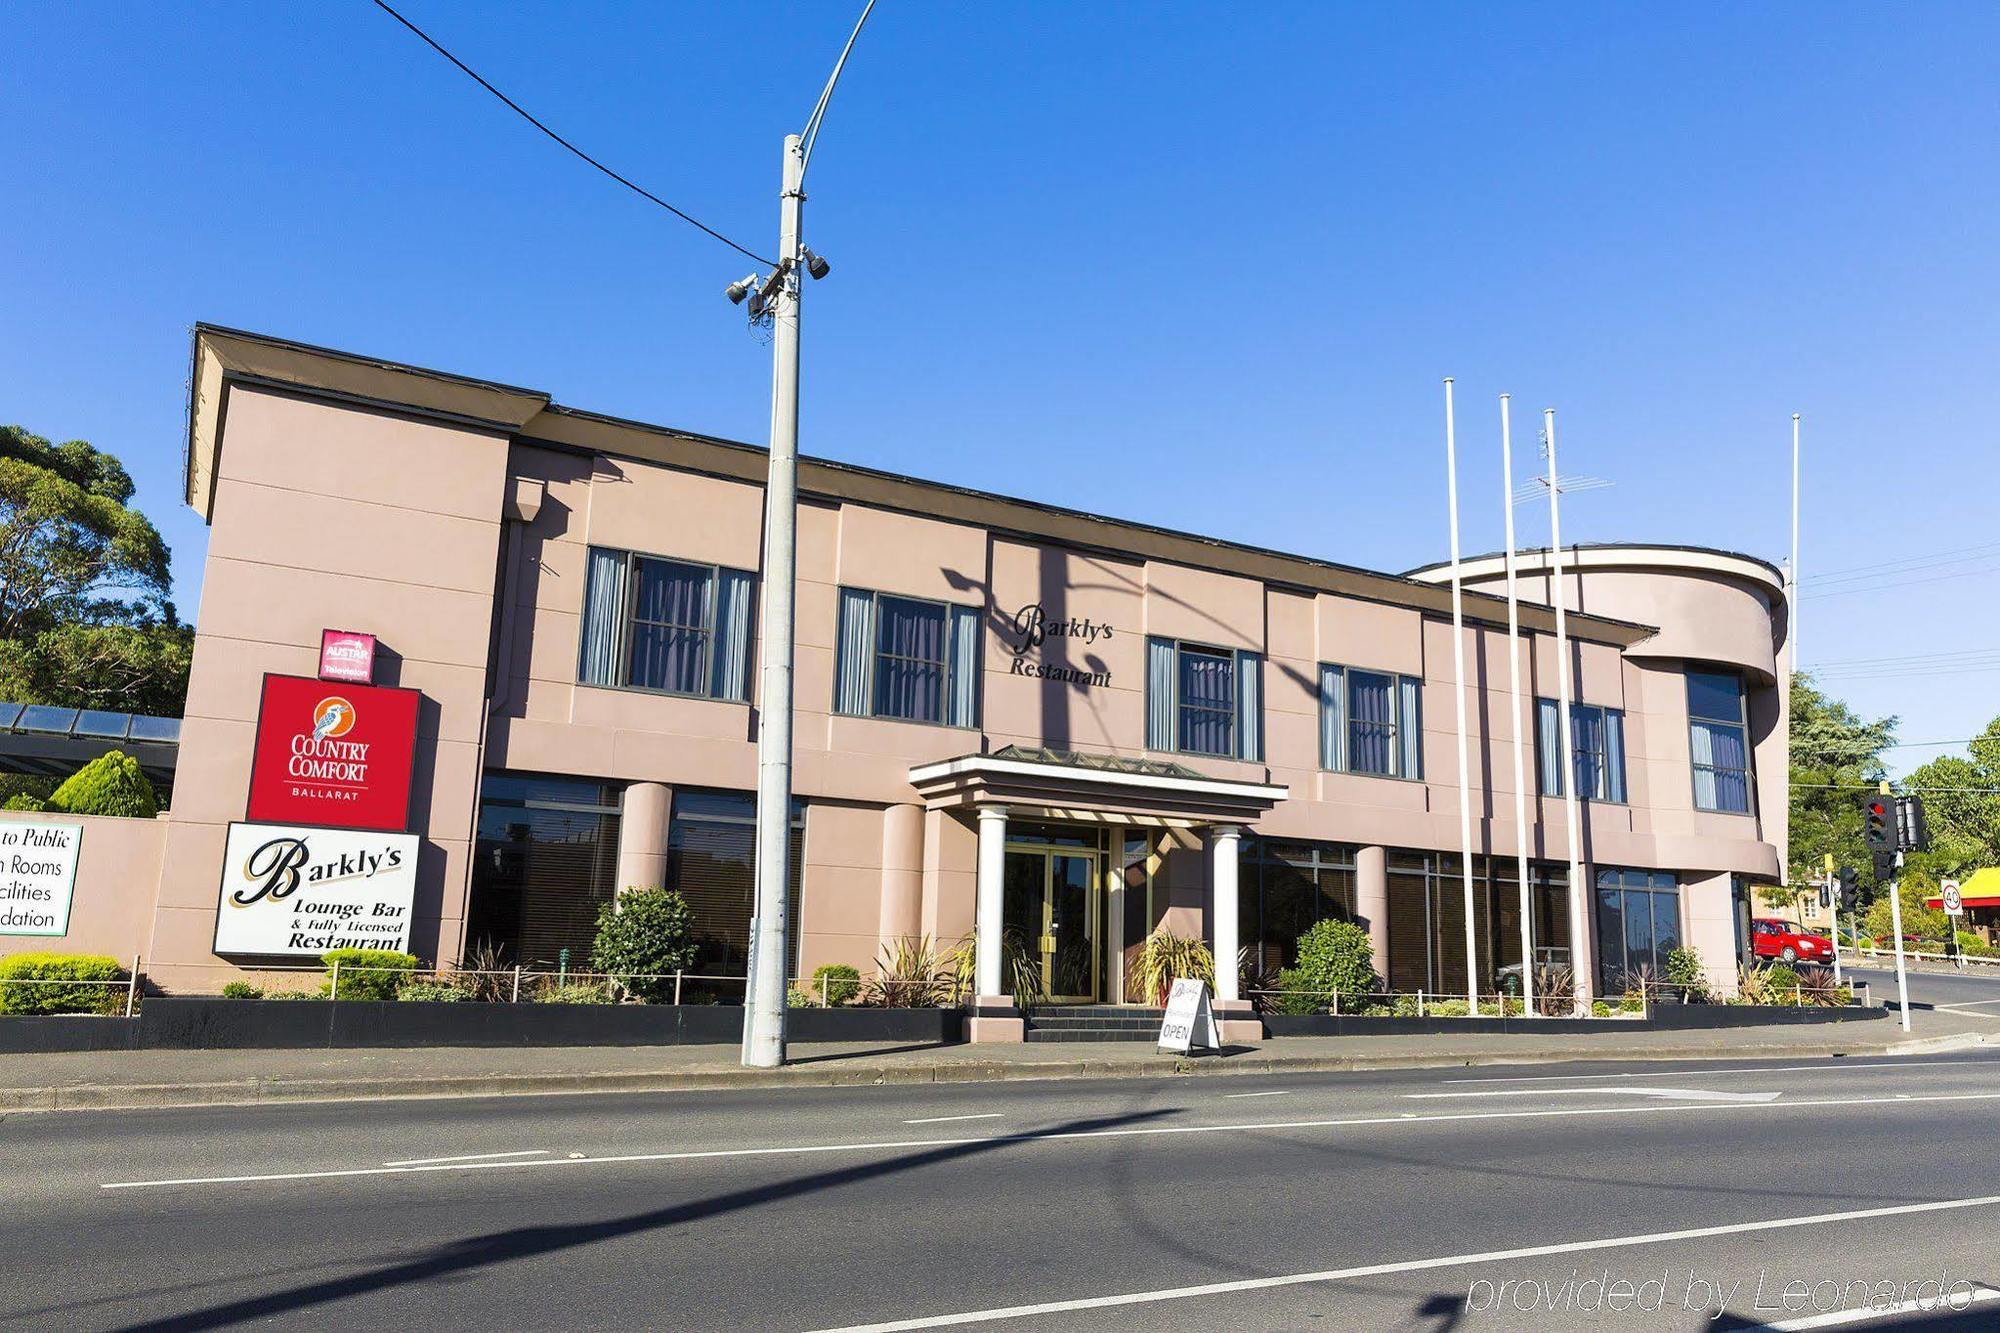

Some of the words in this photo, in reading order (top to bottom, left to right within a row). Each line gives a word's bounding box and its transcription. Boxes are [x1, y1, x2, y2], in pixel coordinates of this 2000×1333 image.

[1014, 601, 1113, 655] Barkly's
[326, 646, 369, 660] AUSTAR
[324, 664, 368, 678] Television
[1009, 657, 1112, 688] Restaurant
[291, 734, 370, 761] COUNTRY
[288, 755, 368, 782] COMFORT
[292, 787, 359, 801] BALLARAT
[1, 832, 17, 845] to
[23, 828, 70, 848] Public
[11, 854, 62, 876] Rooms
[232, 835, 402, 906] Barkly's
[1946, 891, 1958, 903] 40
[0, 906, 54, 927] dation
[293, 899, 364, 919] Lounge
[372, 902, 406, 918] Bar
[291, 918, 302, 930] &
[308, 919, 342, 932] Fully
[347, 921, 404, 933] Licensed
[288, 932, 403, 951] Restaurant
[1163, 1024, 1189, 1039] OPEN
